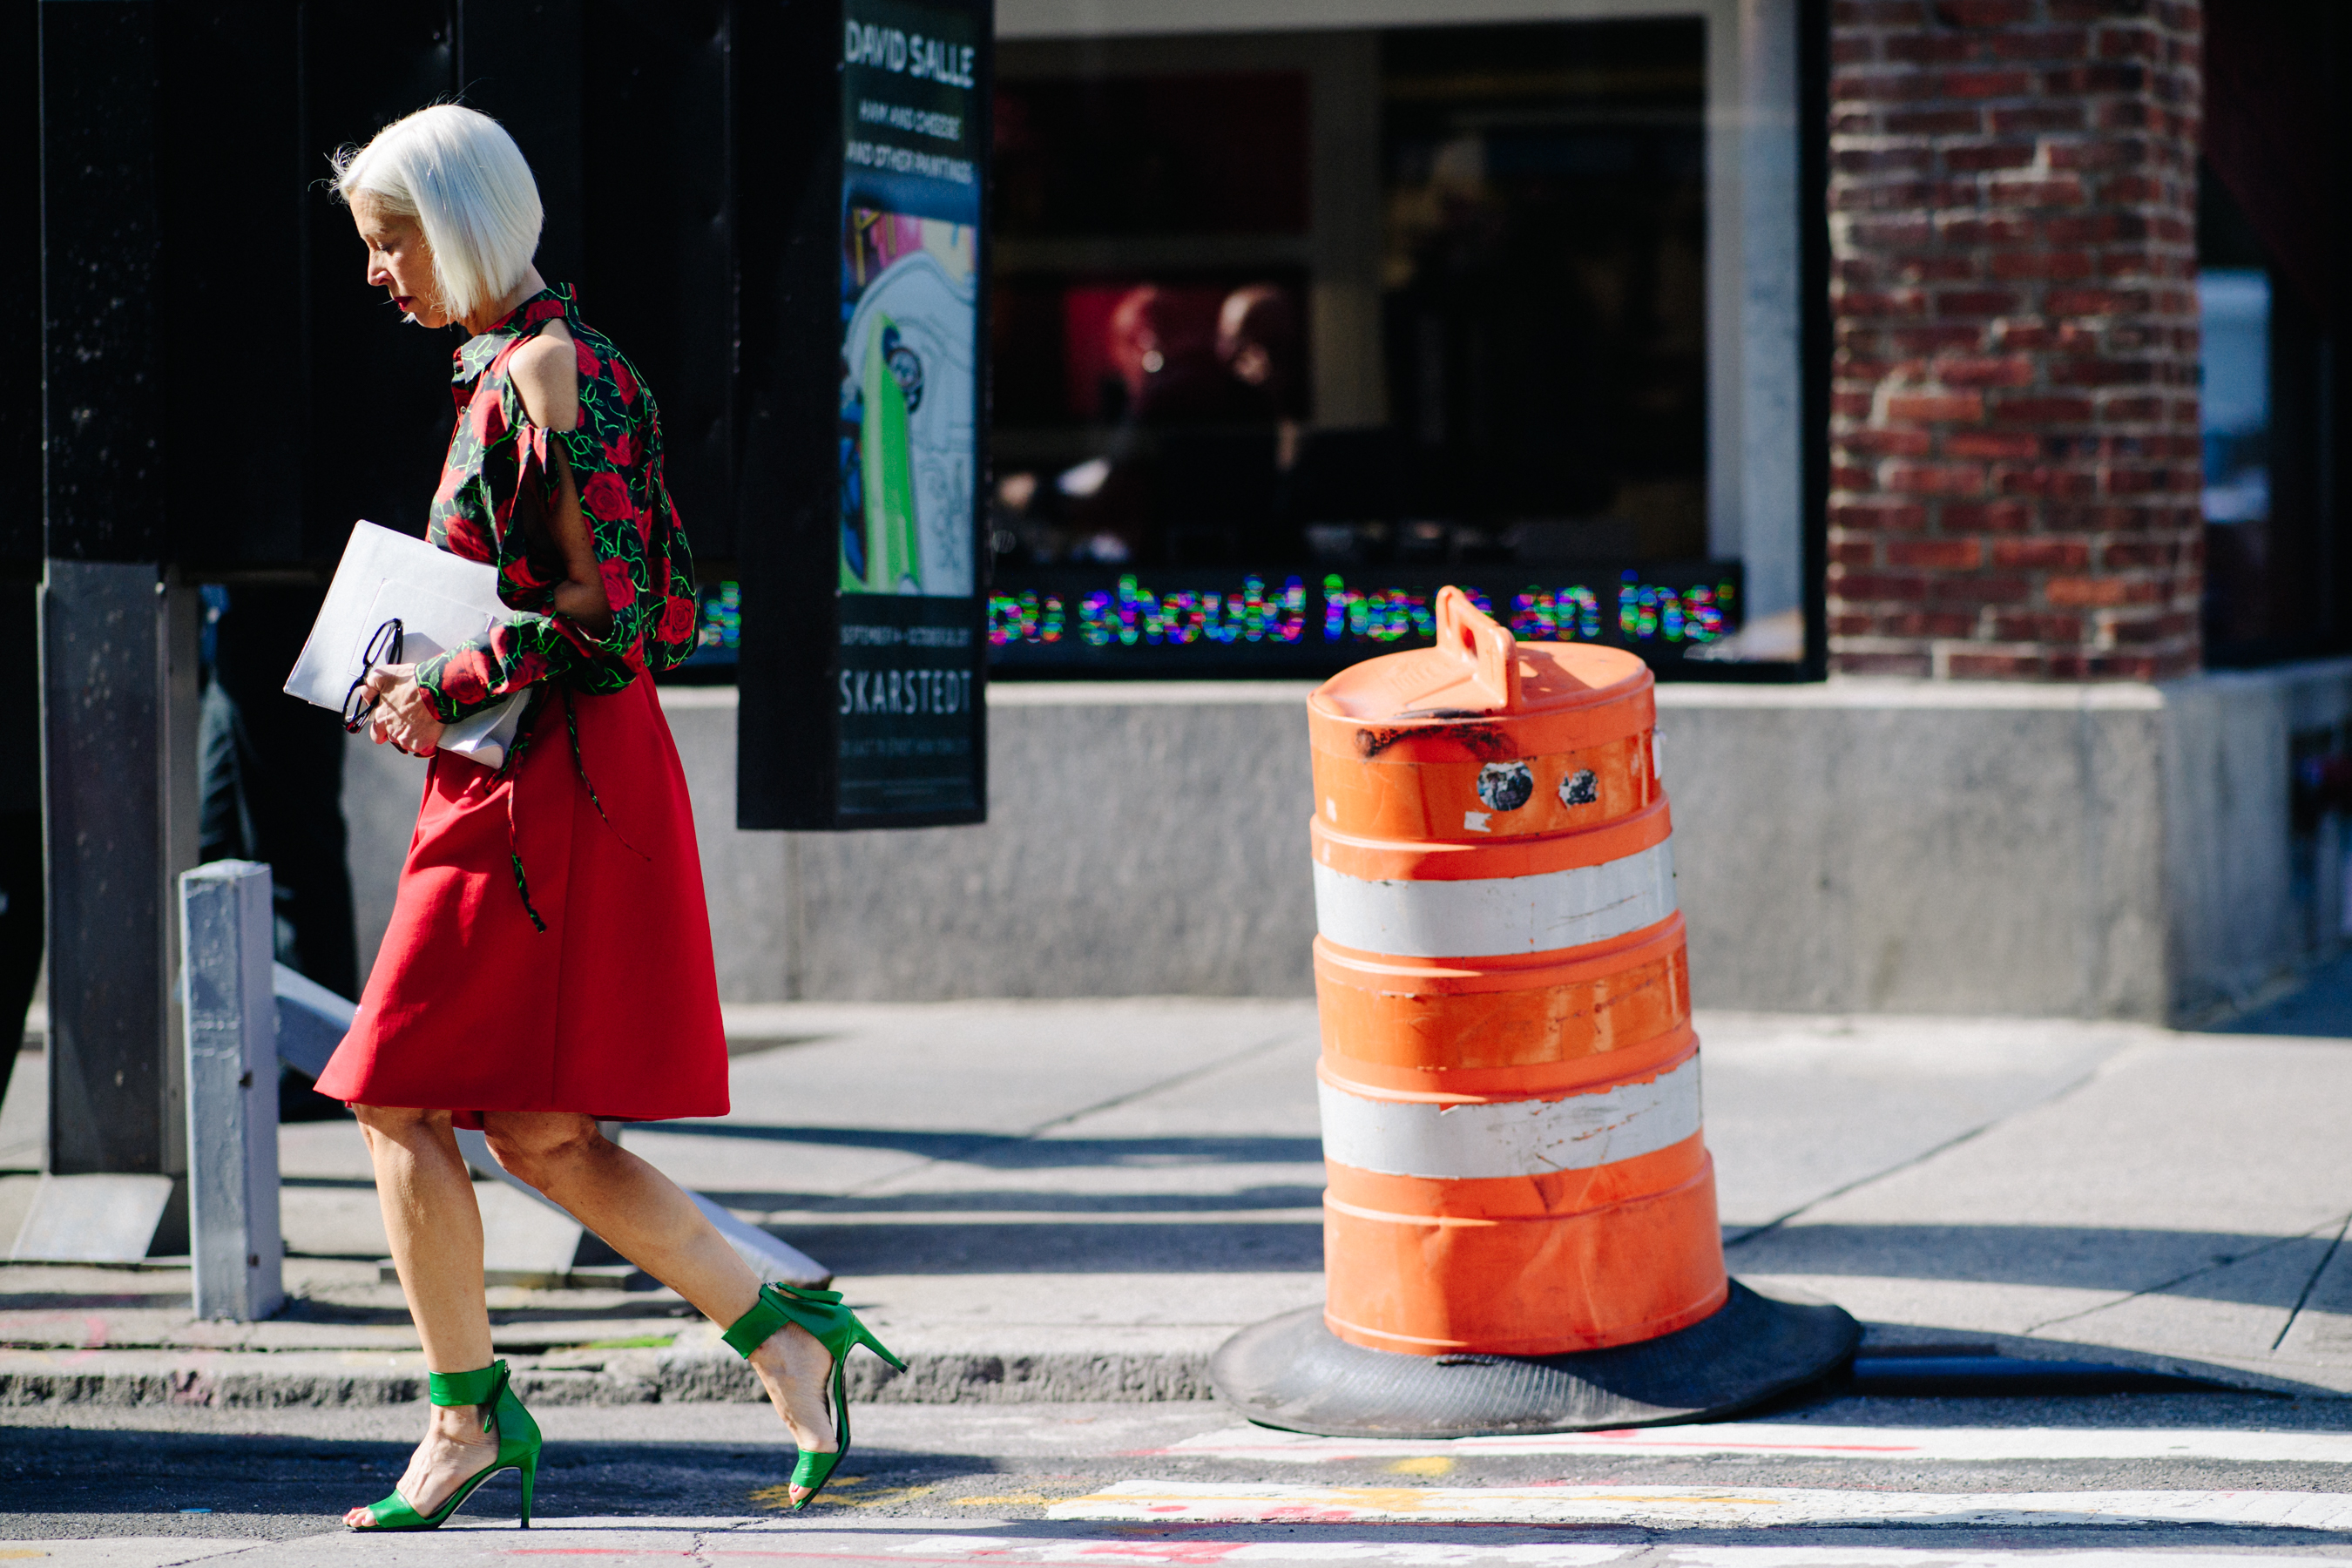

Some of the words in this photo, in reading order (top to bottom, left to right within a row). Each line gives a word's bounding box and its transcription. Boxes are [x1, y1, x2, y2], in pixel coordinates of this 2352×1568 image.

[845, 19, 908, 73] DAVID
[909, 34, 975, 89] SALLE
[1079, 573, 1306, 645] should
[1510, 585, 1601, 641] an
[839, 669, 971, 714] SKARSTEDT
